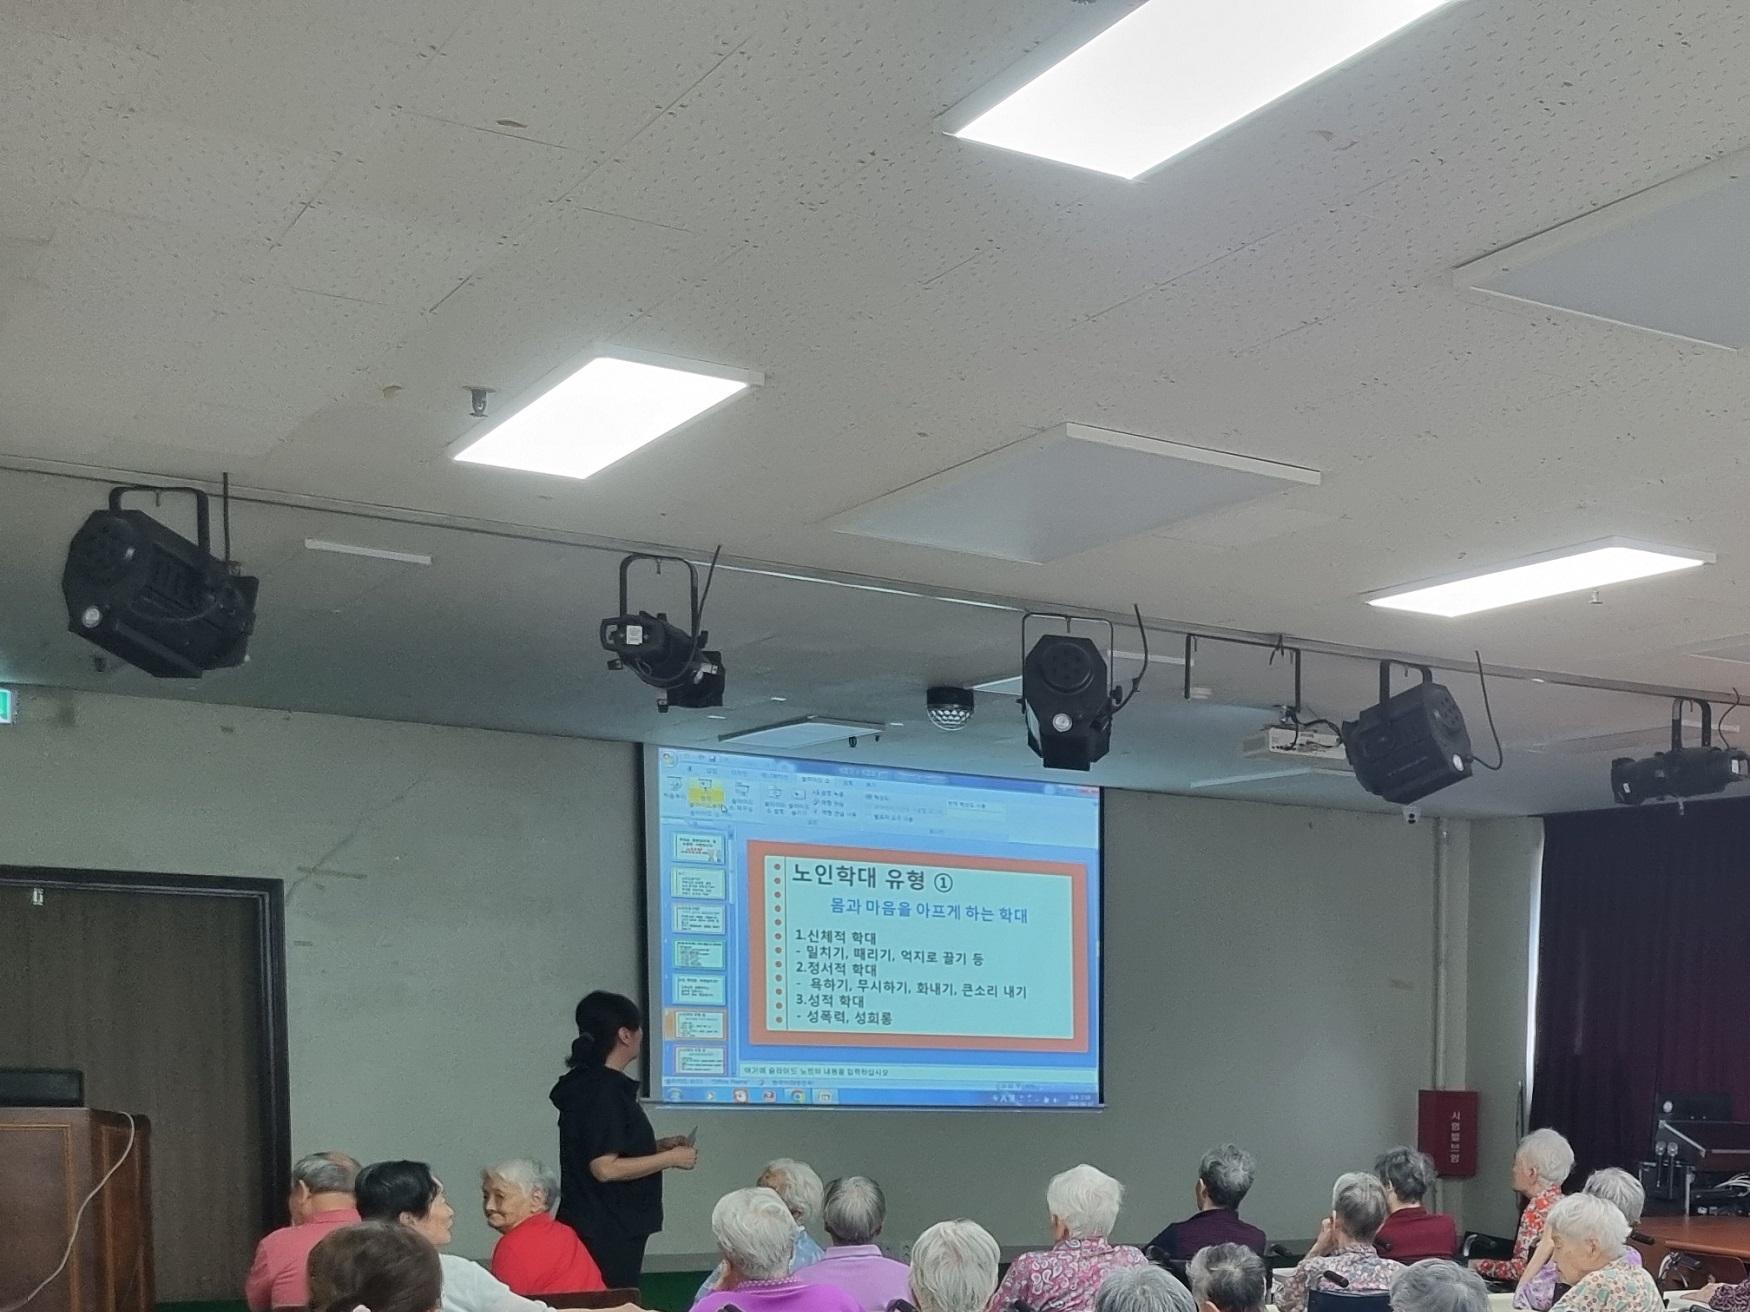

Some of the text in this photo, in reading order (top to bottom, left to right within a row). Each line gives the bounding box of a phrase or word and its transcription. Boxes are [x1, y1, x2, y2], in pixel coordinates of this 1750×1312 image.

[791, 863, 877, 889] 노인학대
[885, 869, 926, 891] 유형
[830, 897, 1028, 924] 몸과 마음을 아프게 하는 학대
[795, 928, 877, 945] 1.신체적 학대
[806, 945, 849, 961] 밀치기,
[853, 946, 896, 962] 때리기,
[900, 949, 938, 965] 억지로
[972, 952, 985, 967] 등
[795, 961, 877, 977] 2.정서적 학대
[810, 977, 853, 993] 욕하기,
[857, 979, 912, 995] 무시하기,
[916, 981, 958, 996] 화내기,
[961, 983, 999, 998] 큰소리
[1003, 985, 1027, 1000] 내기
[795, 993, 865, 1009] 3.성적 학대
[807, 1010, 850, 1025] 성폭력,
[854, 1011, 893, 1026] 성희롱
